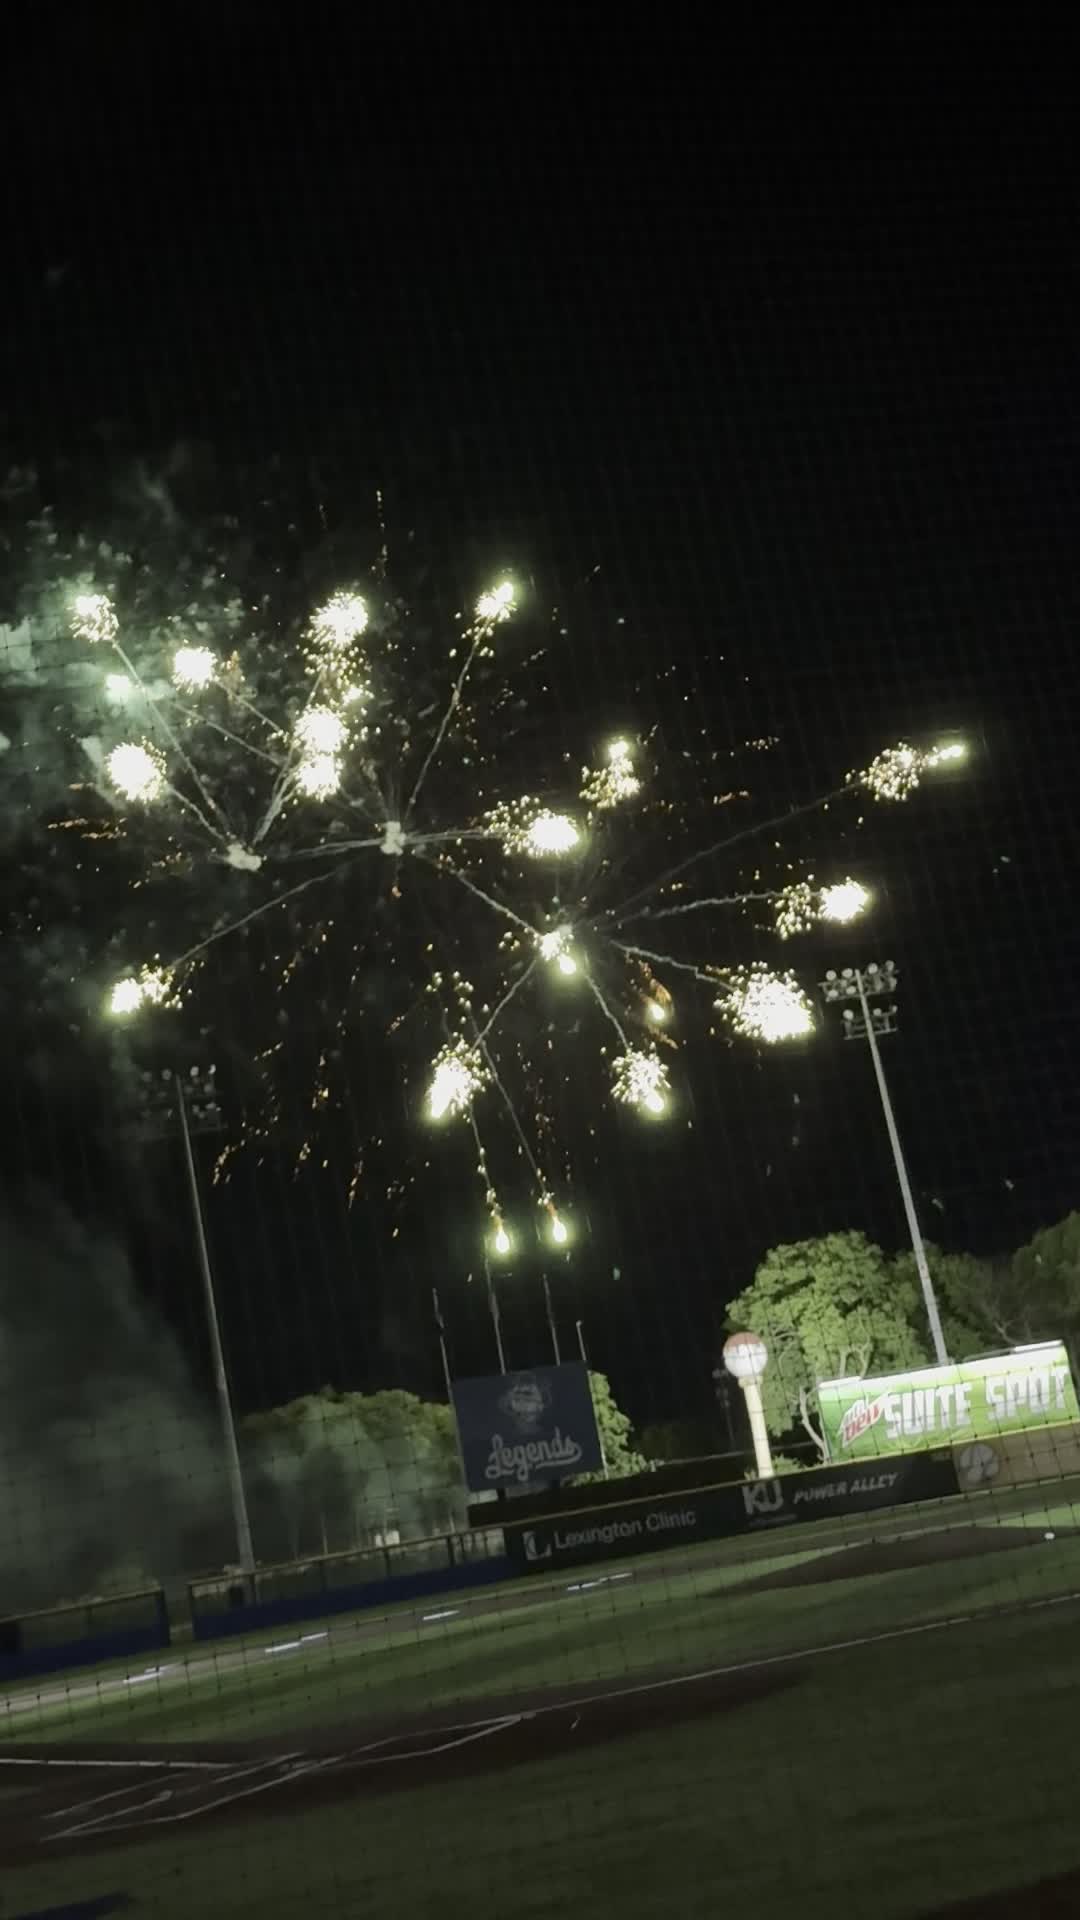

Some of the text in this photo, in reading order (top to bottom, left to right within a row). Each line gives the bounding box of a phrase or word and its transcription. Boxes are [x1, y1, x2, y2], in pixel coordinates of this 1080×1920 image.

[885, 1381, 972, 1439] SUITE
[985, 1363, 1070, 1421] SPOT
[485, 1426, 582, 1481] Legends
[742, 1479, 784, 1514] KU
[793, 1472, 898, 1504] POWER ALLEY
[554, 1509, 697, 1549] Lexington Clinic
